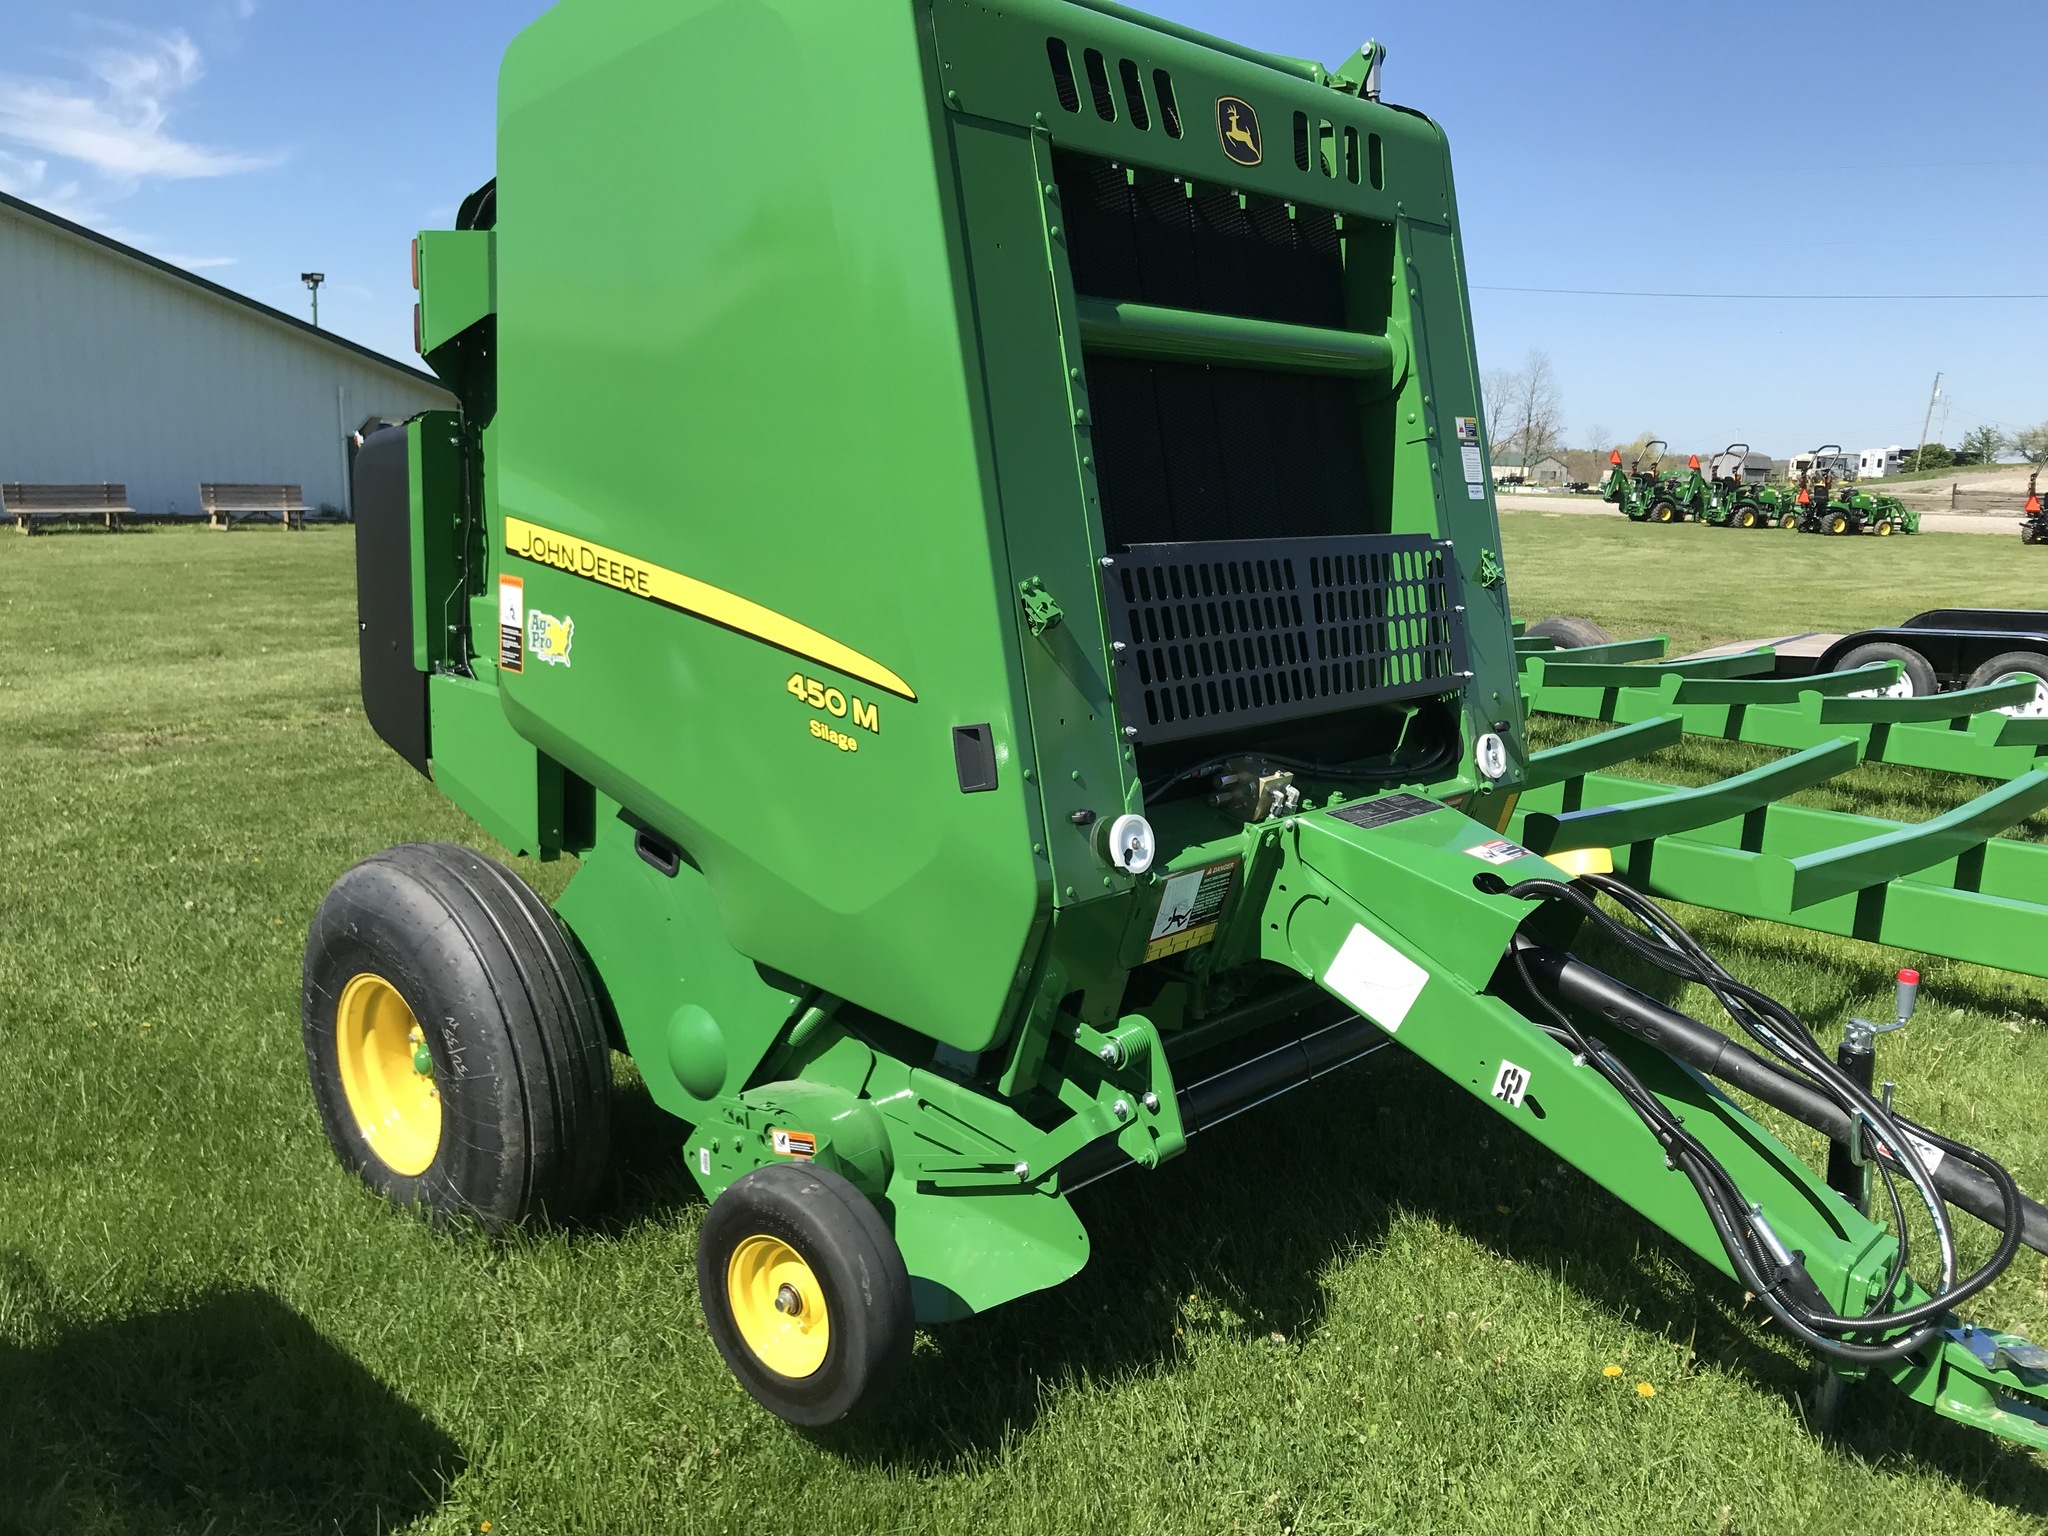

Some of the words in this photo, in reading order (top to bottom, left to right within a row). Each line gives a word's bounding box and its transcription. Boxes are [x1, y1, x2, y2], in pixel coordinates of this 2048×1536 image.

[522, 530, 574, 567] JOHN
[581, 546, 650, 593] DEERE
[531, 632, 552, 649] Pro
[787, 672, 847, 718] 450
[852, 695, 879, 735] M
[809, 719, 858, 752] Silage
[1212, 862, 1235, 874] DANGER
